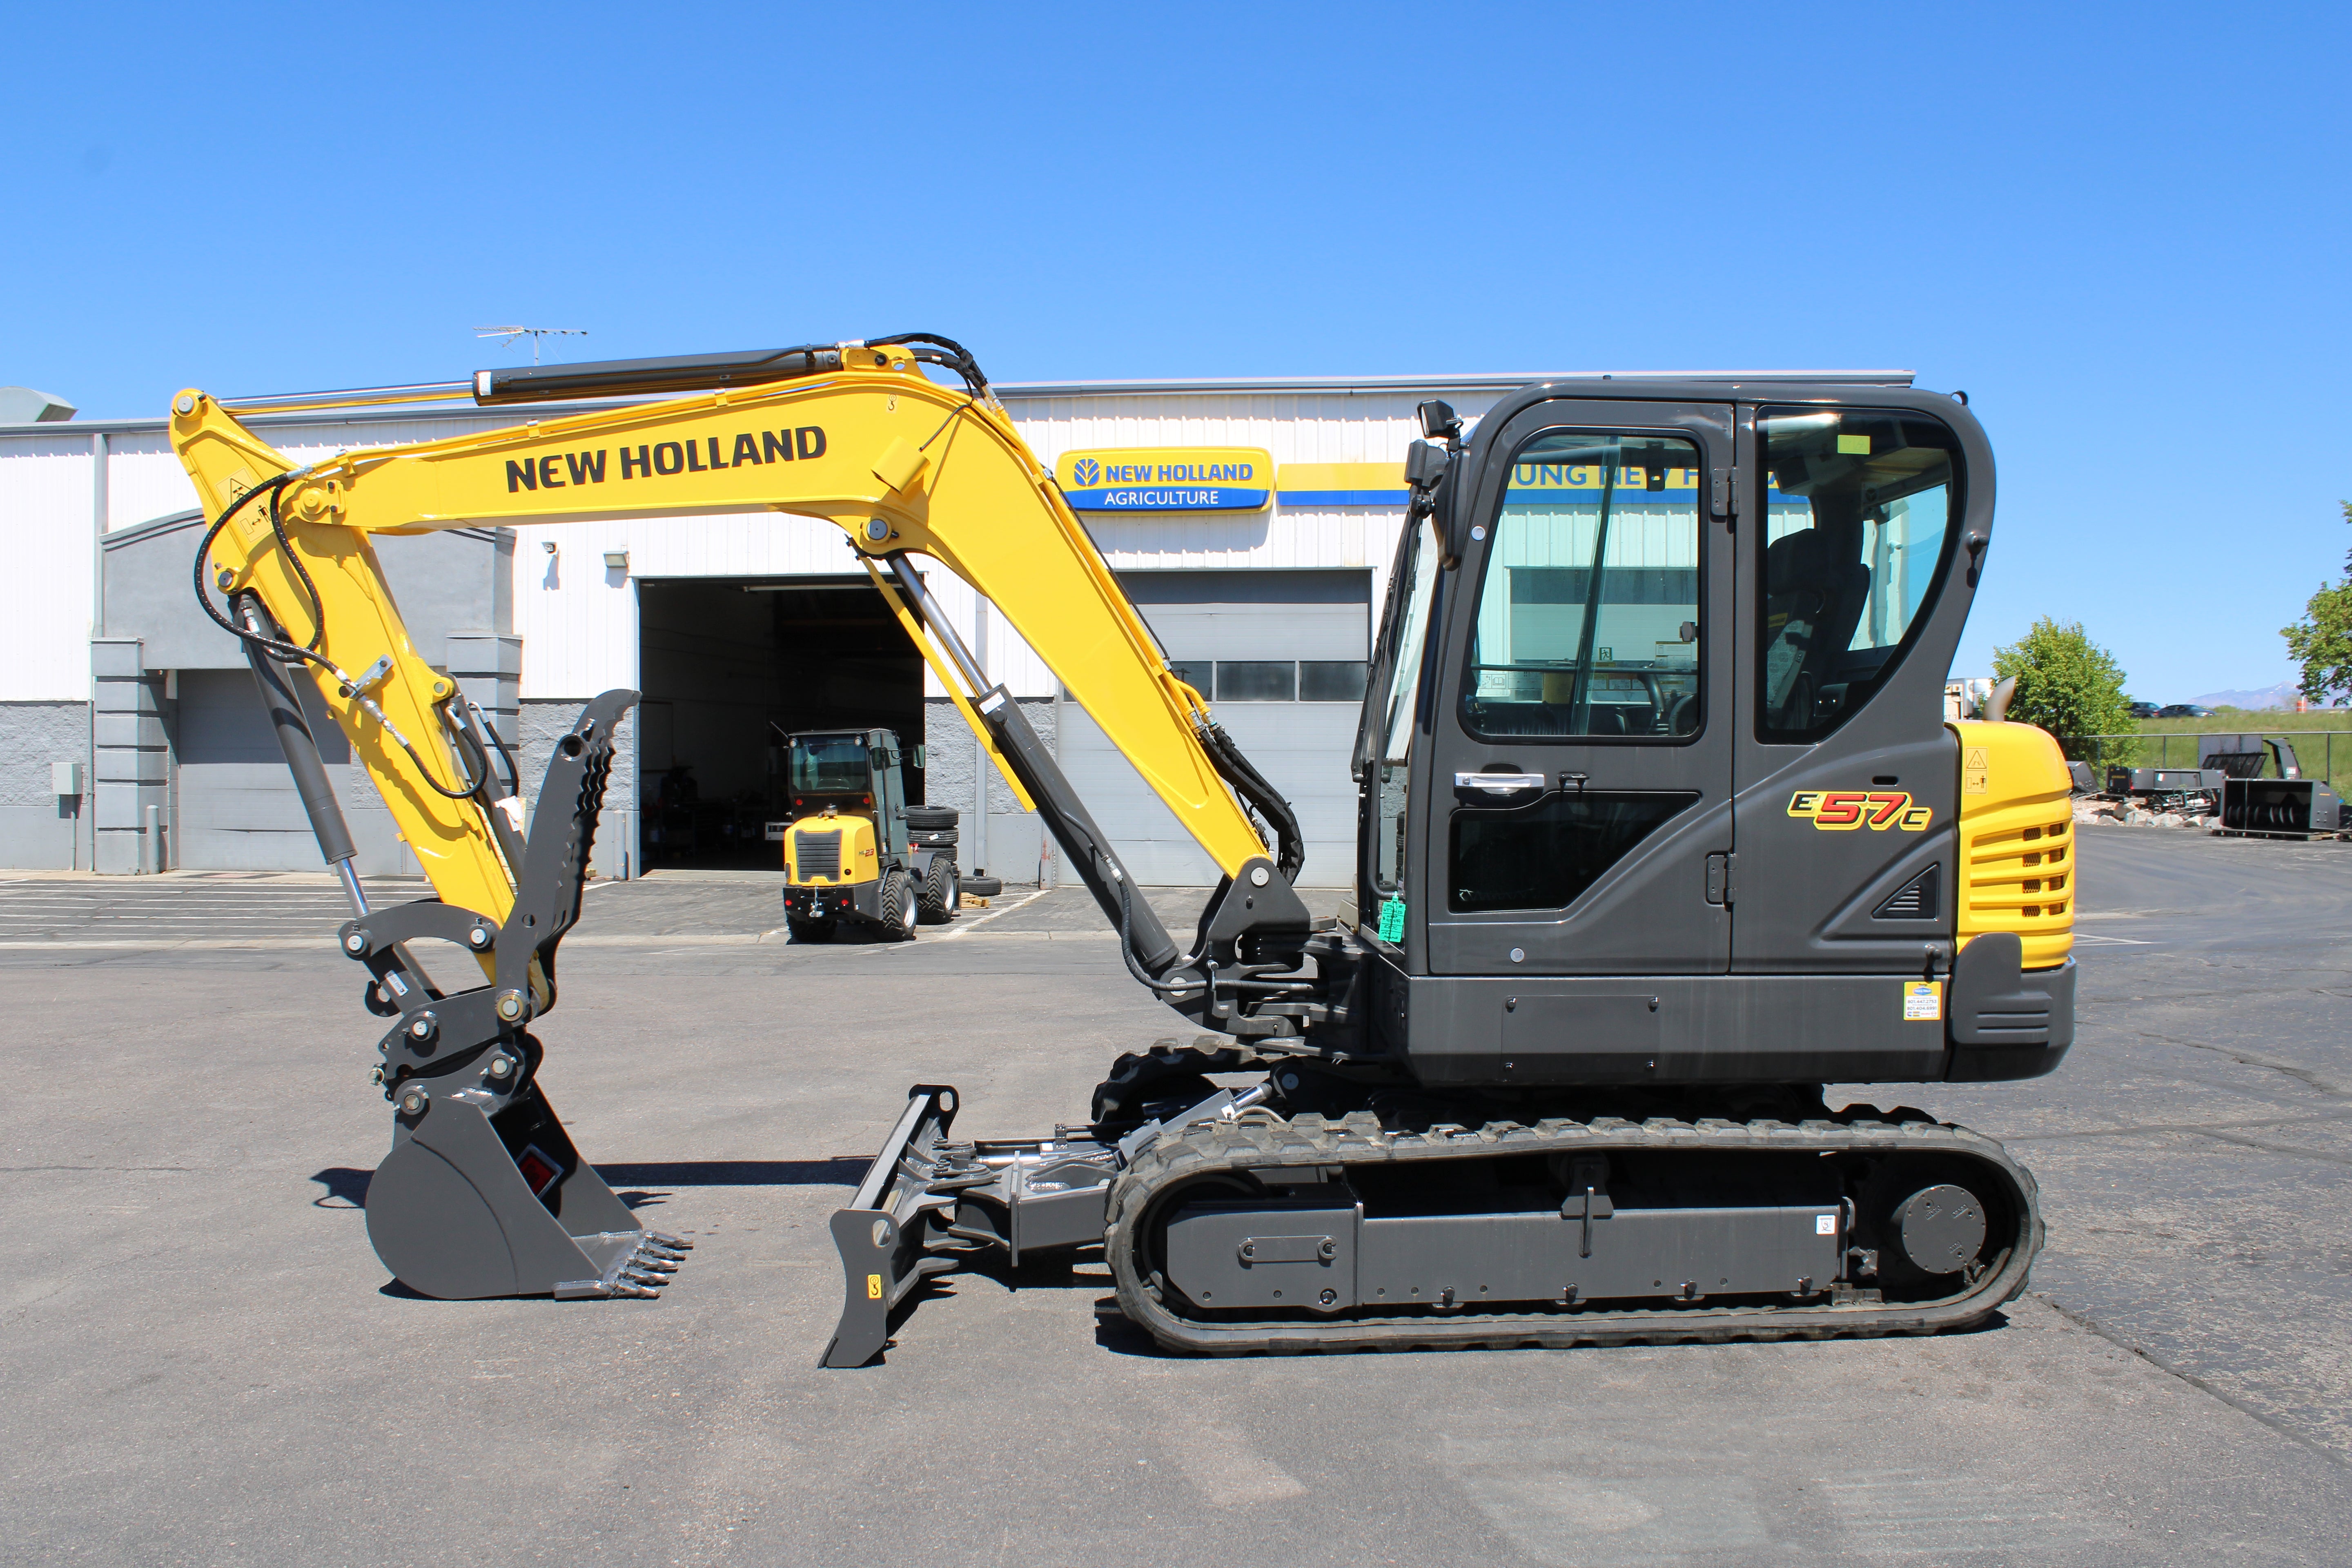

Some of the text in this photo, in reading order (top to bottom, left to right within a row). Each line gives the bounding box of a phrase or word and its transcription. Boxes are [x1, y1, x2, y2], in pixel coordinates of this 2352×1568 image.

[505, 425, 826, 493] NEW HOLLAND
[1106, 464, 1253, 482] NEW HOLLAND
[1104, 491, 1218, 506] AGRICULTURE
